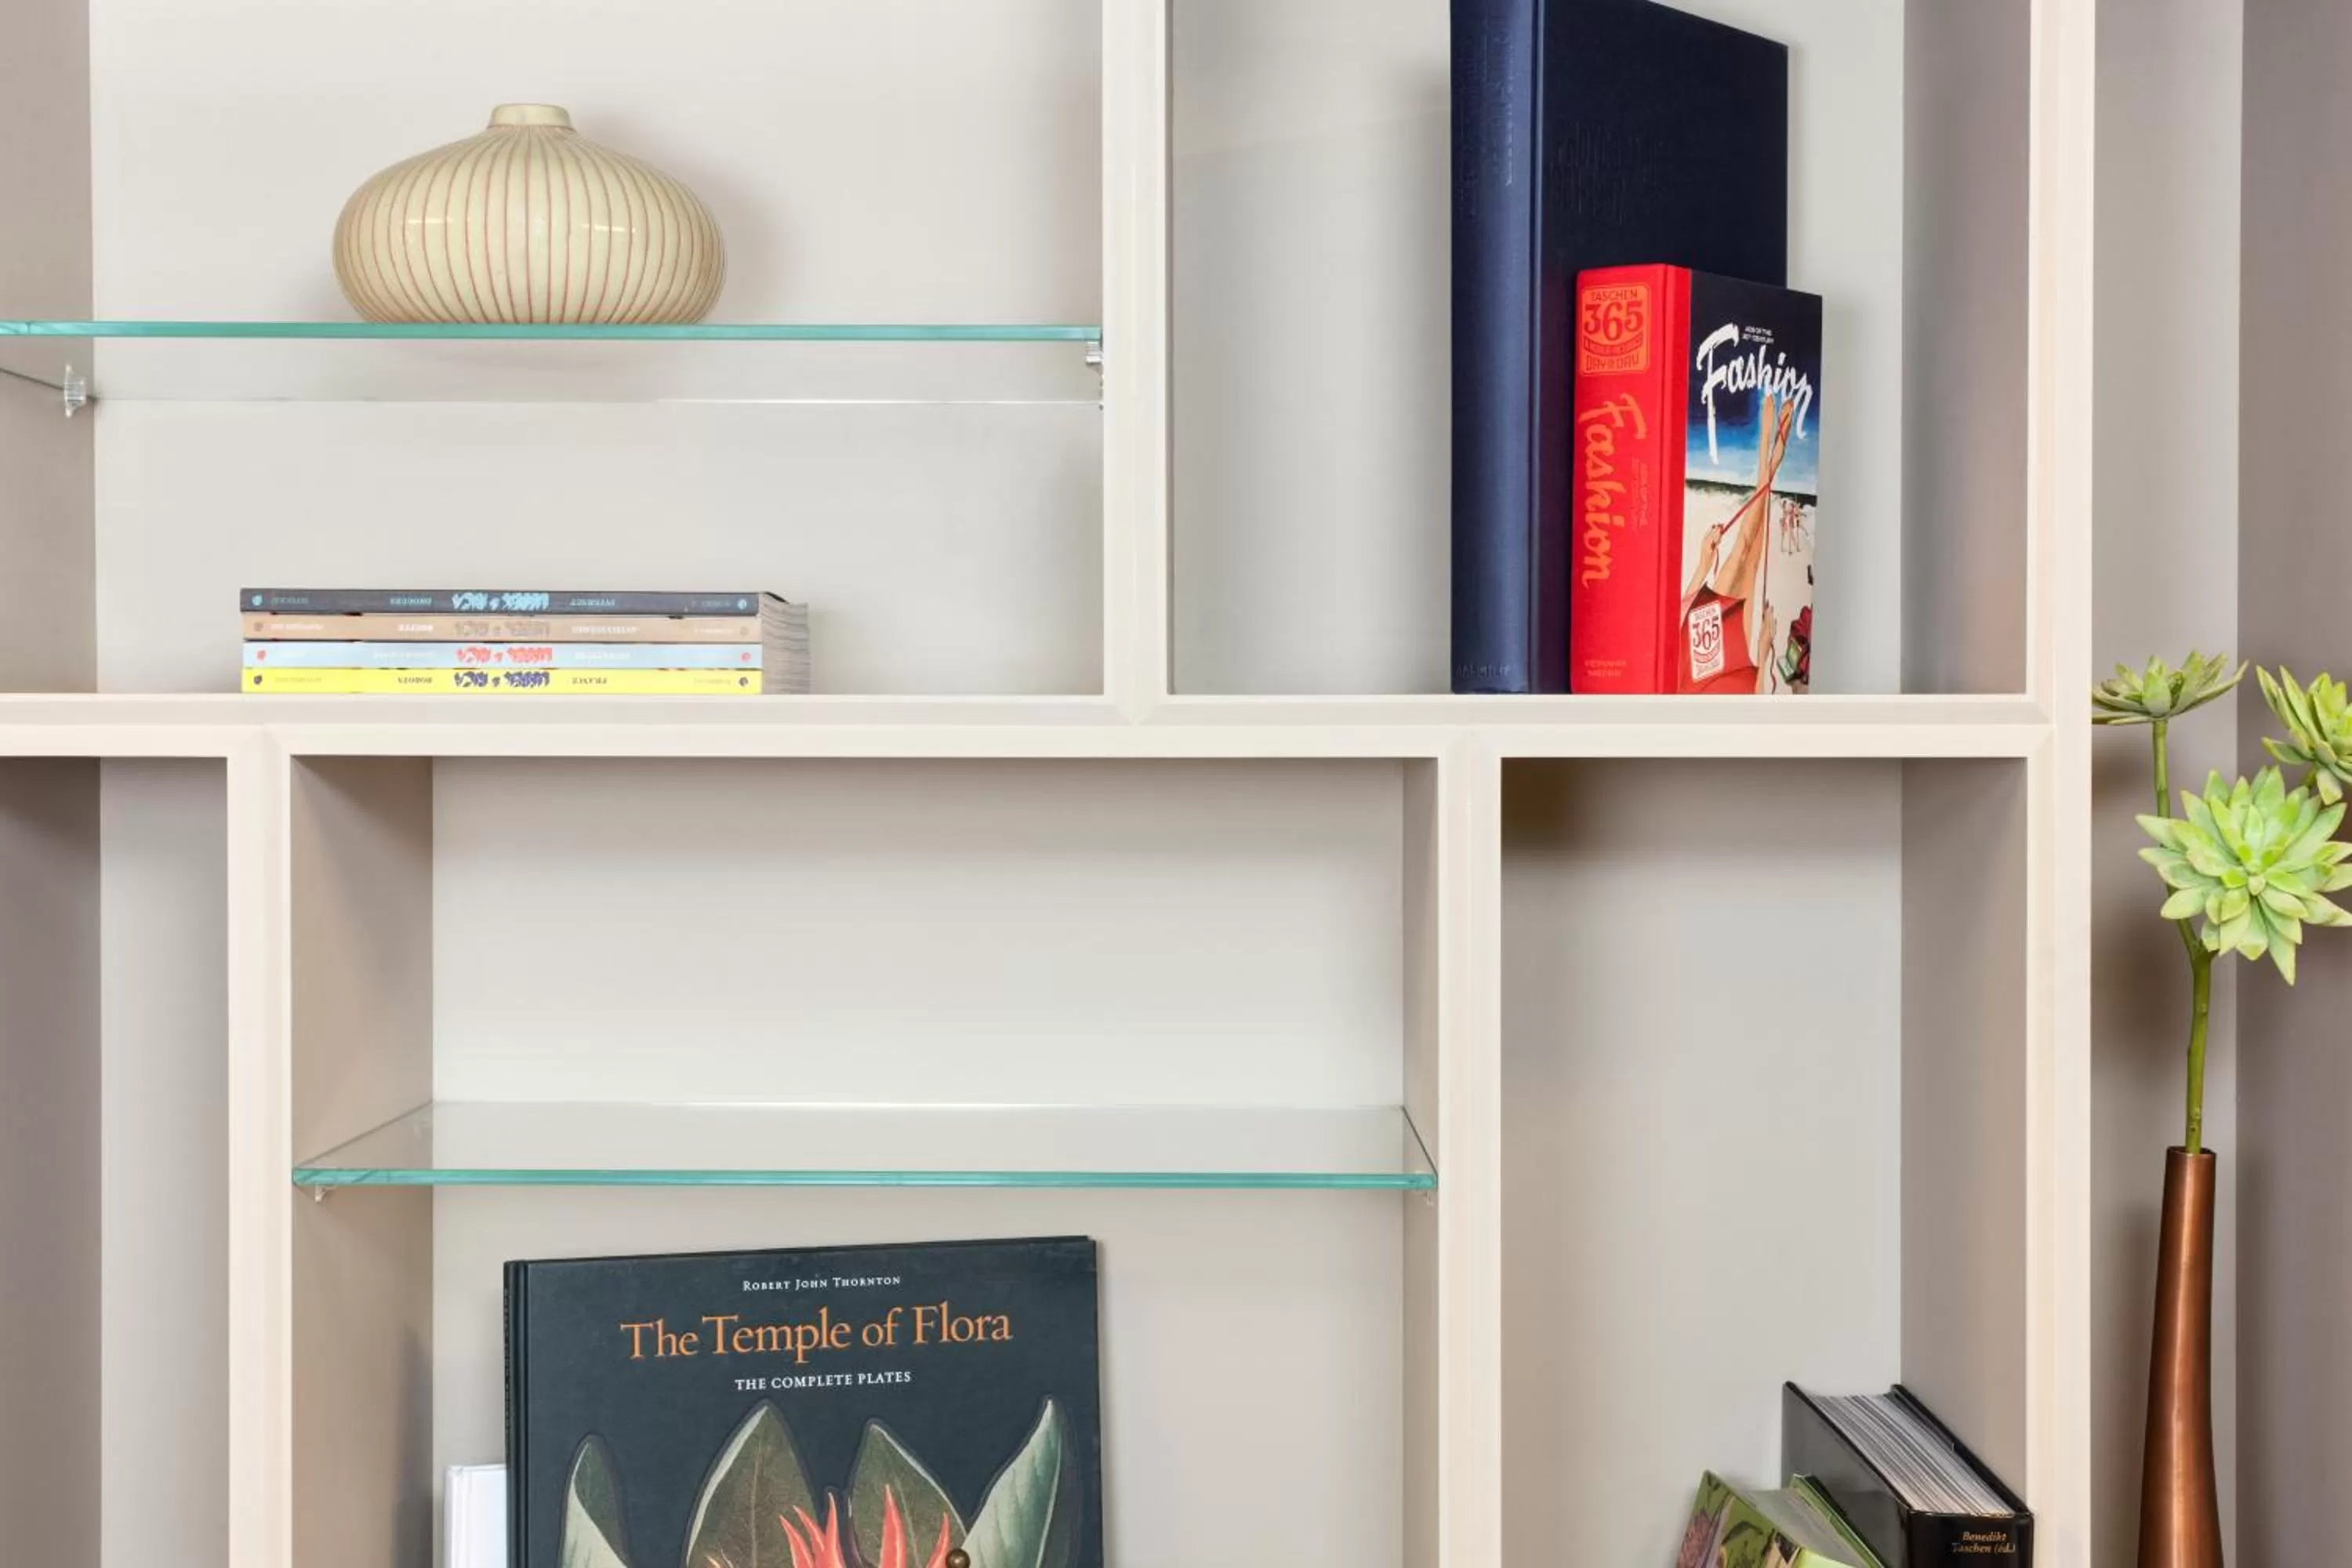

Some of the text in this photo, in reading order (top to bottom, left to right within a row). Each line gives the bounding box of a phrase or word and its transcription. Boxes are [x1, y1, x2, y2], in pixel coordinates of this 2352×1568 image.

[1591, 288, 1639, 301] TASCHEN
[1584, 300, 1644, 342] 365
[1696, 322, 1813, 466] Fashion
[1577, 392, 1647, 590] Fashion
[1692, 615, 1720, 650] 365
[742, 1276, 901, 1292] ROBERT JOHN THORNTON
[620, 1299, 1014, 1364] The Temple of Flora
[734, 1371, 913, 1391] THE COMPLETE PLATES
[1951, 1542, 1992, 1554] Taschen
[1962, 1530, 2008, 1542] Benedikt
